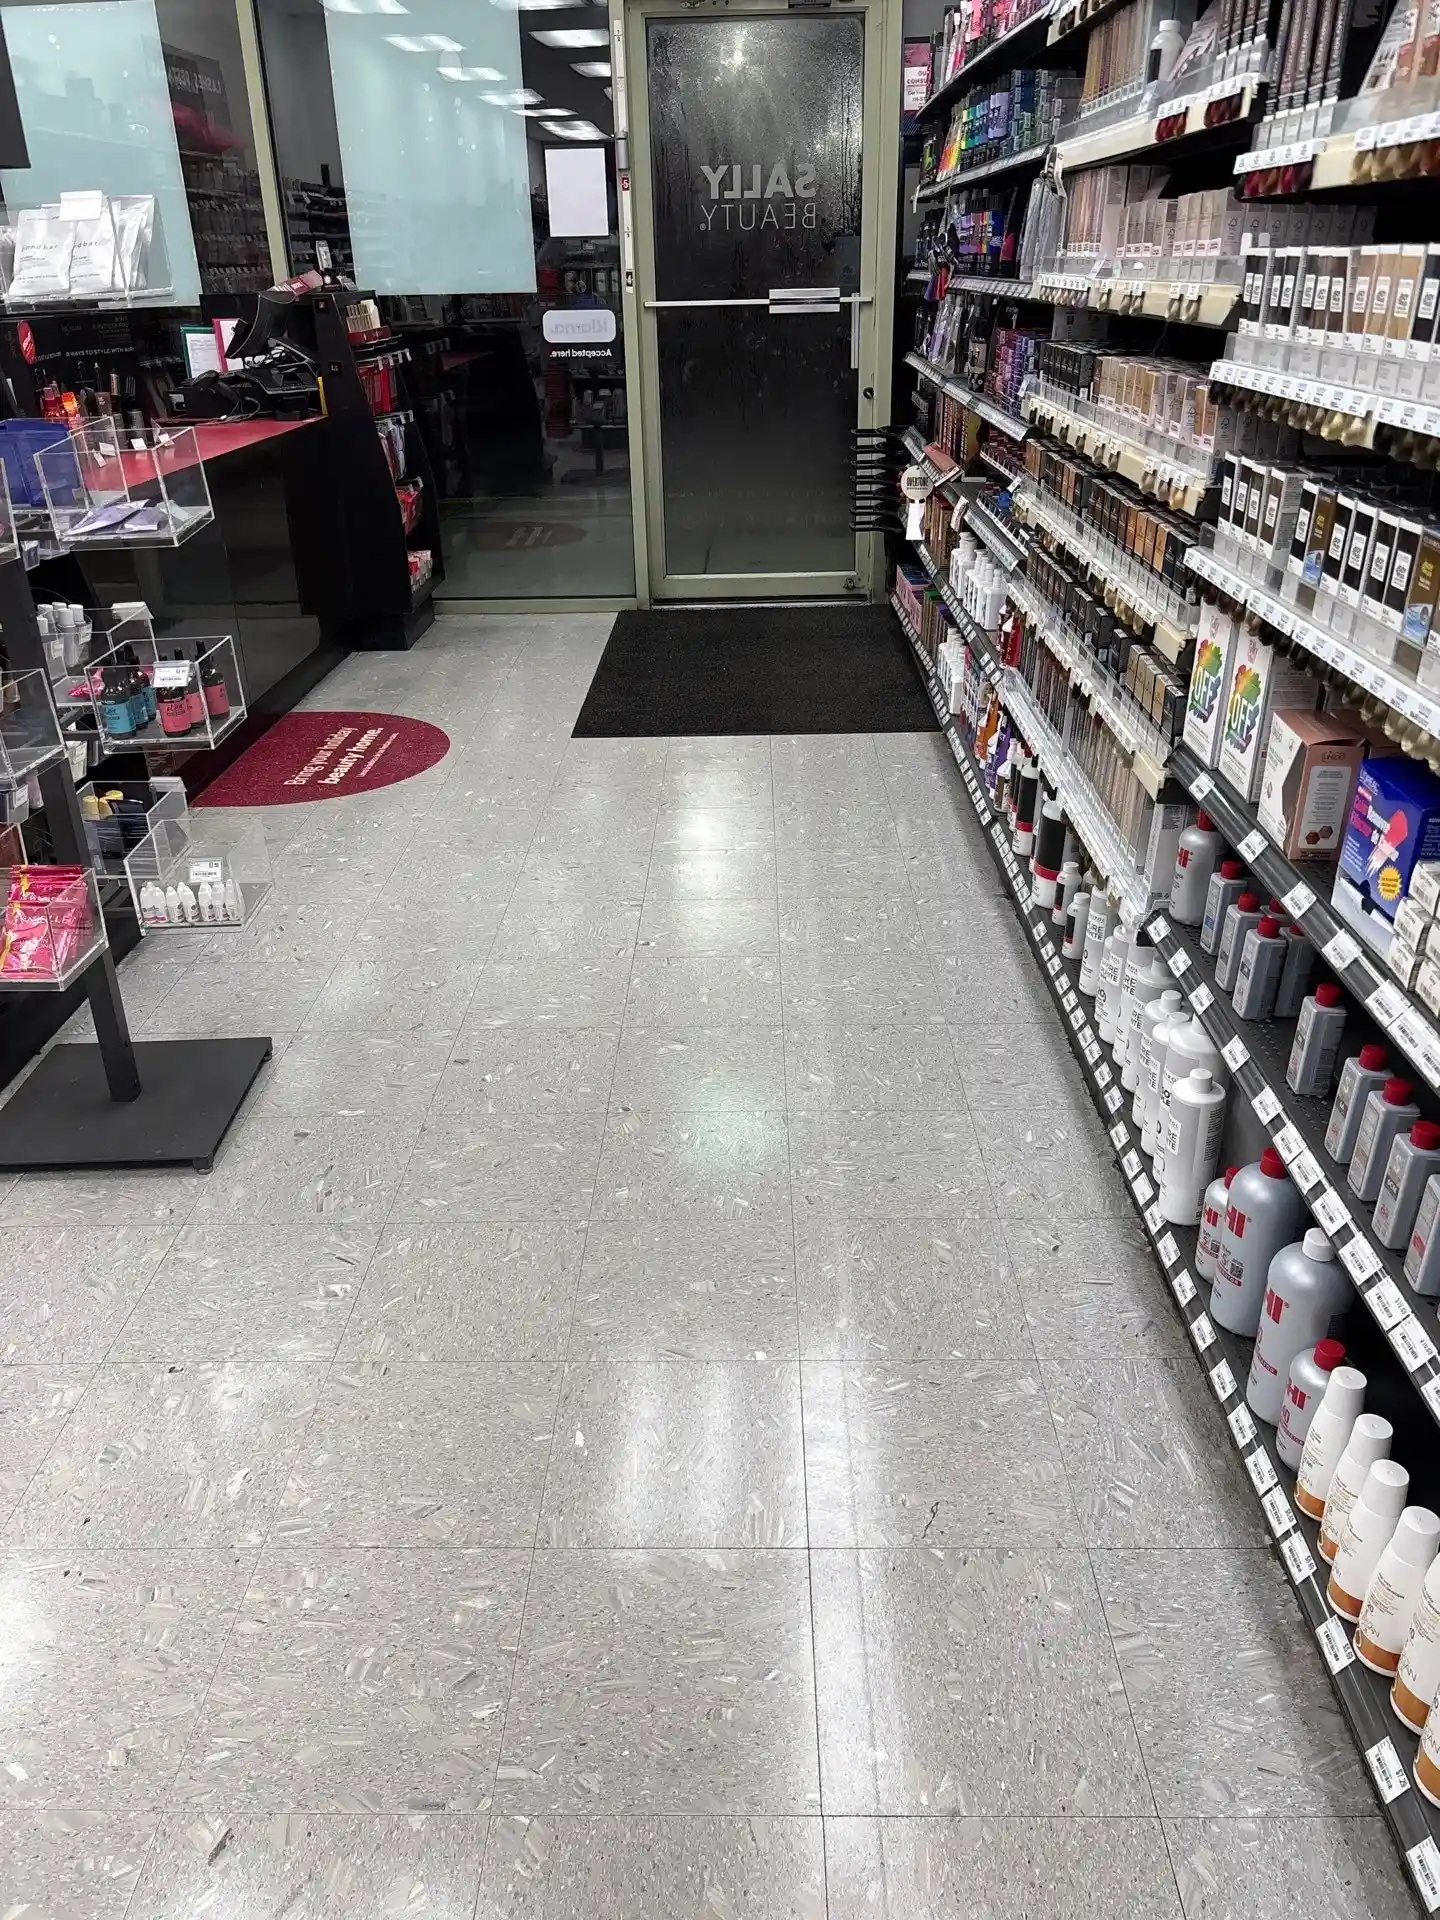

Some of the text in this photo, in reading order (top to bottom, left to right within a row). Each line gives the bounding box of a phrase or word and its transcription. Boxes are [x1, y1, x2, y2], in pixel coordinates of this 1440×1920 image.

[621, 177, 630, 189] 5
[283, 727, 359, 785] Bring your holiday
[317, 752, 365, 785] beauty
[345, 727, 385, 752] home.
